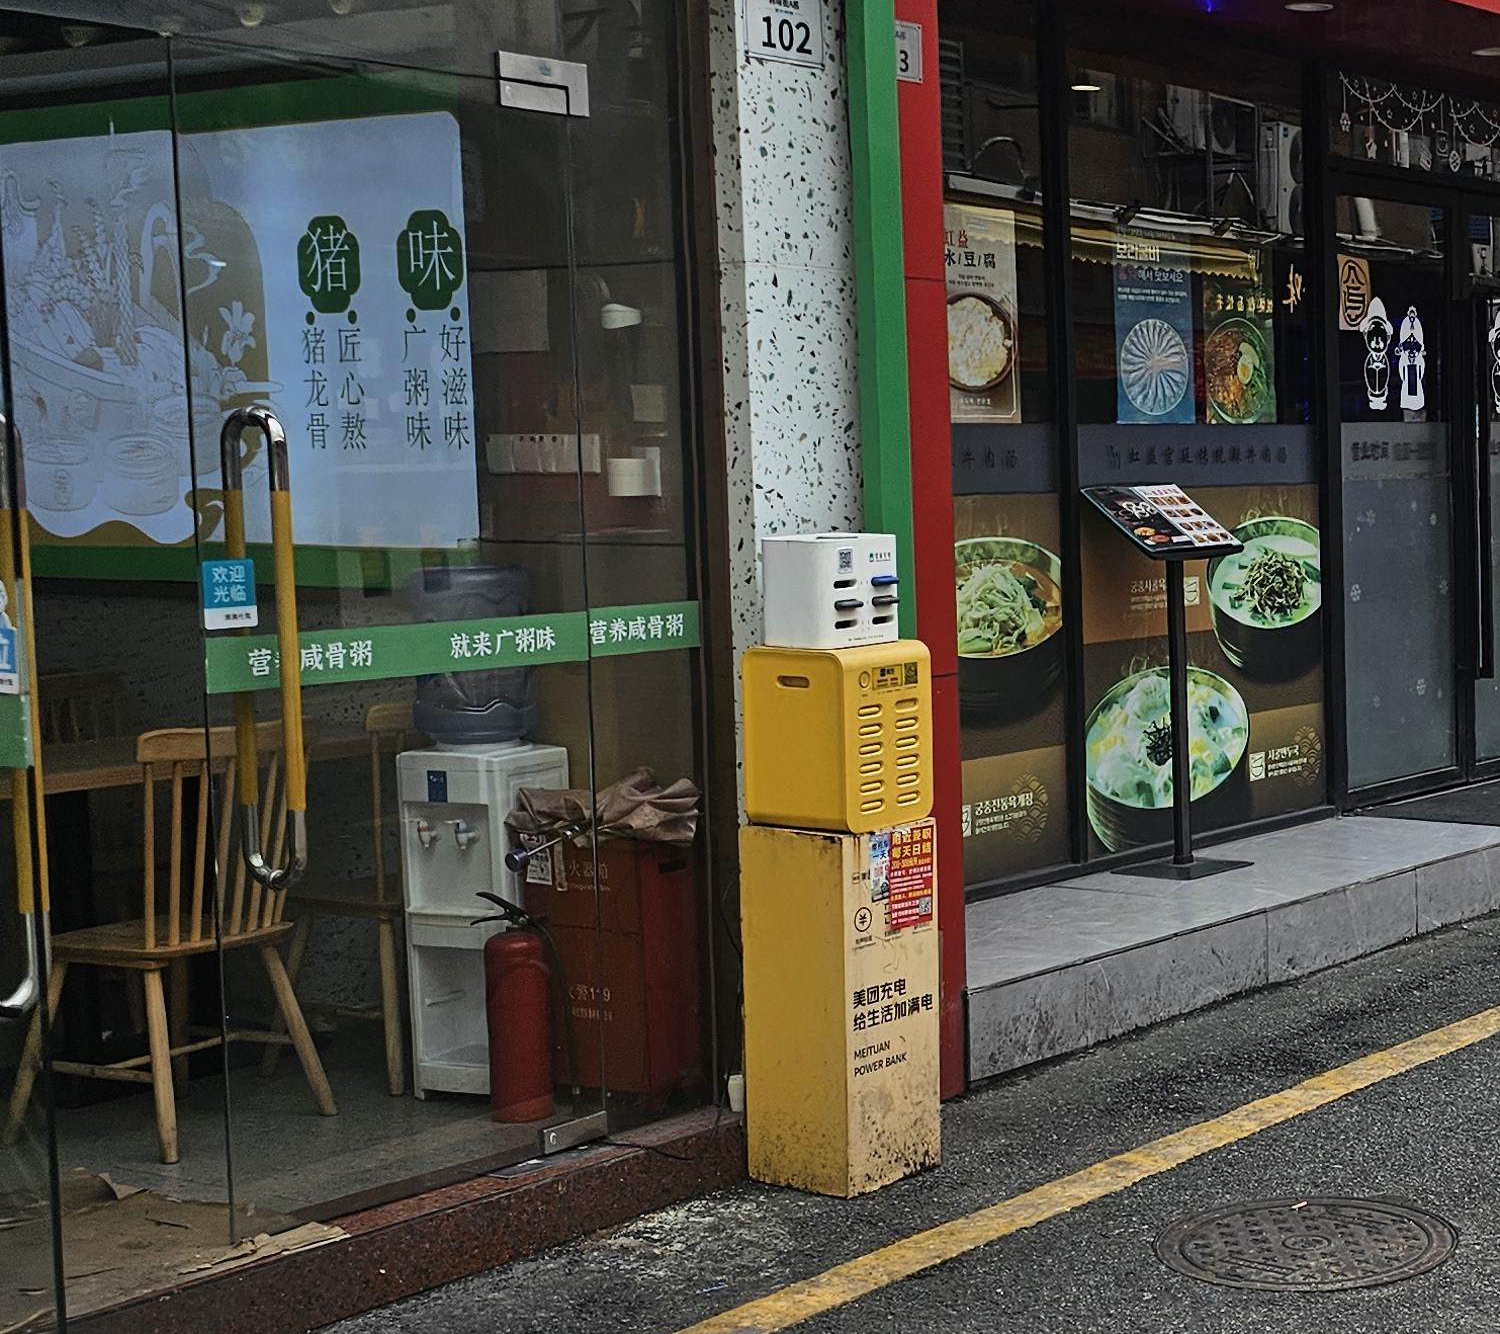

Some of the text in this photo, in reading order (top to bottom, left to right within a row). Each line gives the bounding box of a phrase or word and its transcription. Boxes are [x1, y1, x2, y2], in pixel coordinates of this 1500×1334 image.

[762, 16, 812, 55] 102
[306, 224, 351, 293] 猪
[408, 220, 456, 292] 味
[302, 327, 331, 451] 猪龙骨
[337, 328, 368, 451] 匠心熬
[402, 325, 433, 451] 广粥味
[439, 324, 471, 451] 好滋味
[212, 565, 245, 584] 欢迎
[213, 585, 247, 603] 光临
[450, 626, 557, 659] 就来广粥味
[589, 612, 685, 645] 营养咸骨粥
[248, 639, 373, 677] 营咸骨粥
[853, 978, 907, 1009] 美团充电
[853, 993, 933, 1032] 给生活加满电
[854, 1040, 891, 1060] MEITUAN
[854, 1051, 908, 1078] POWER BANK
